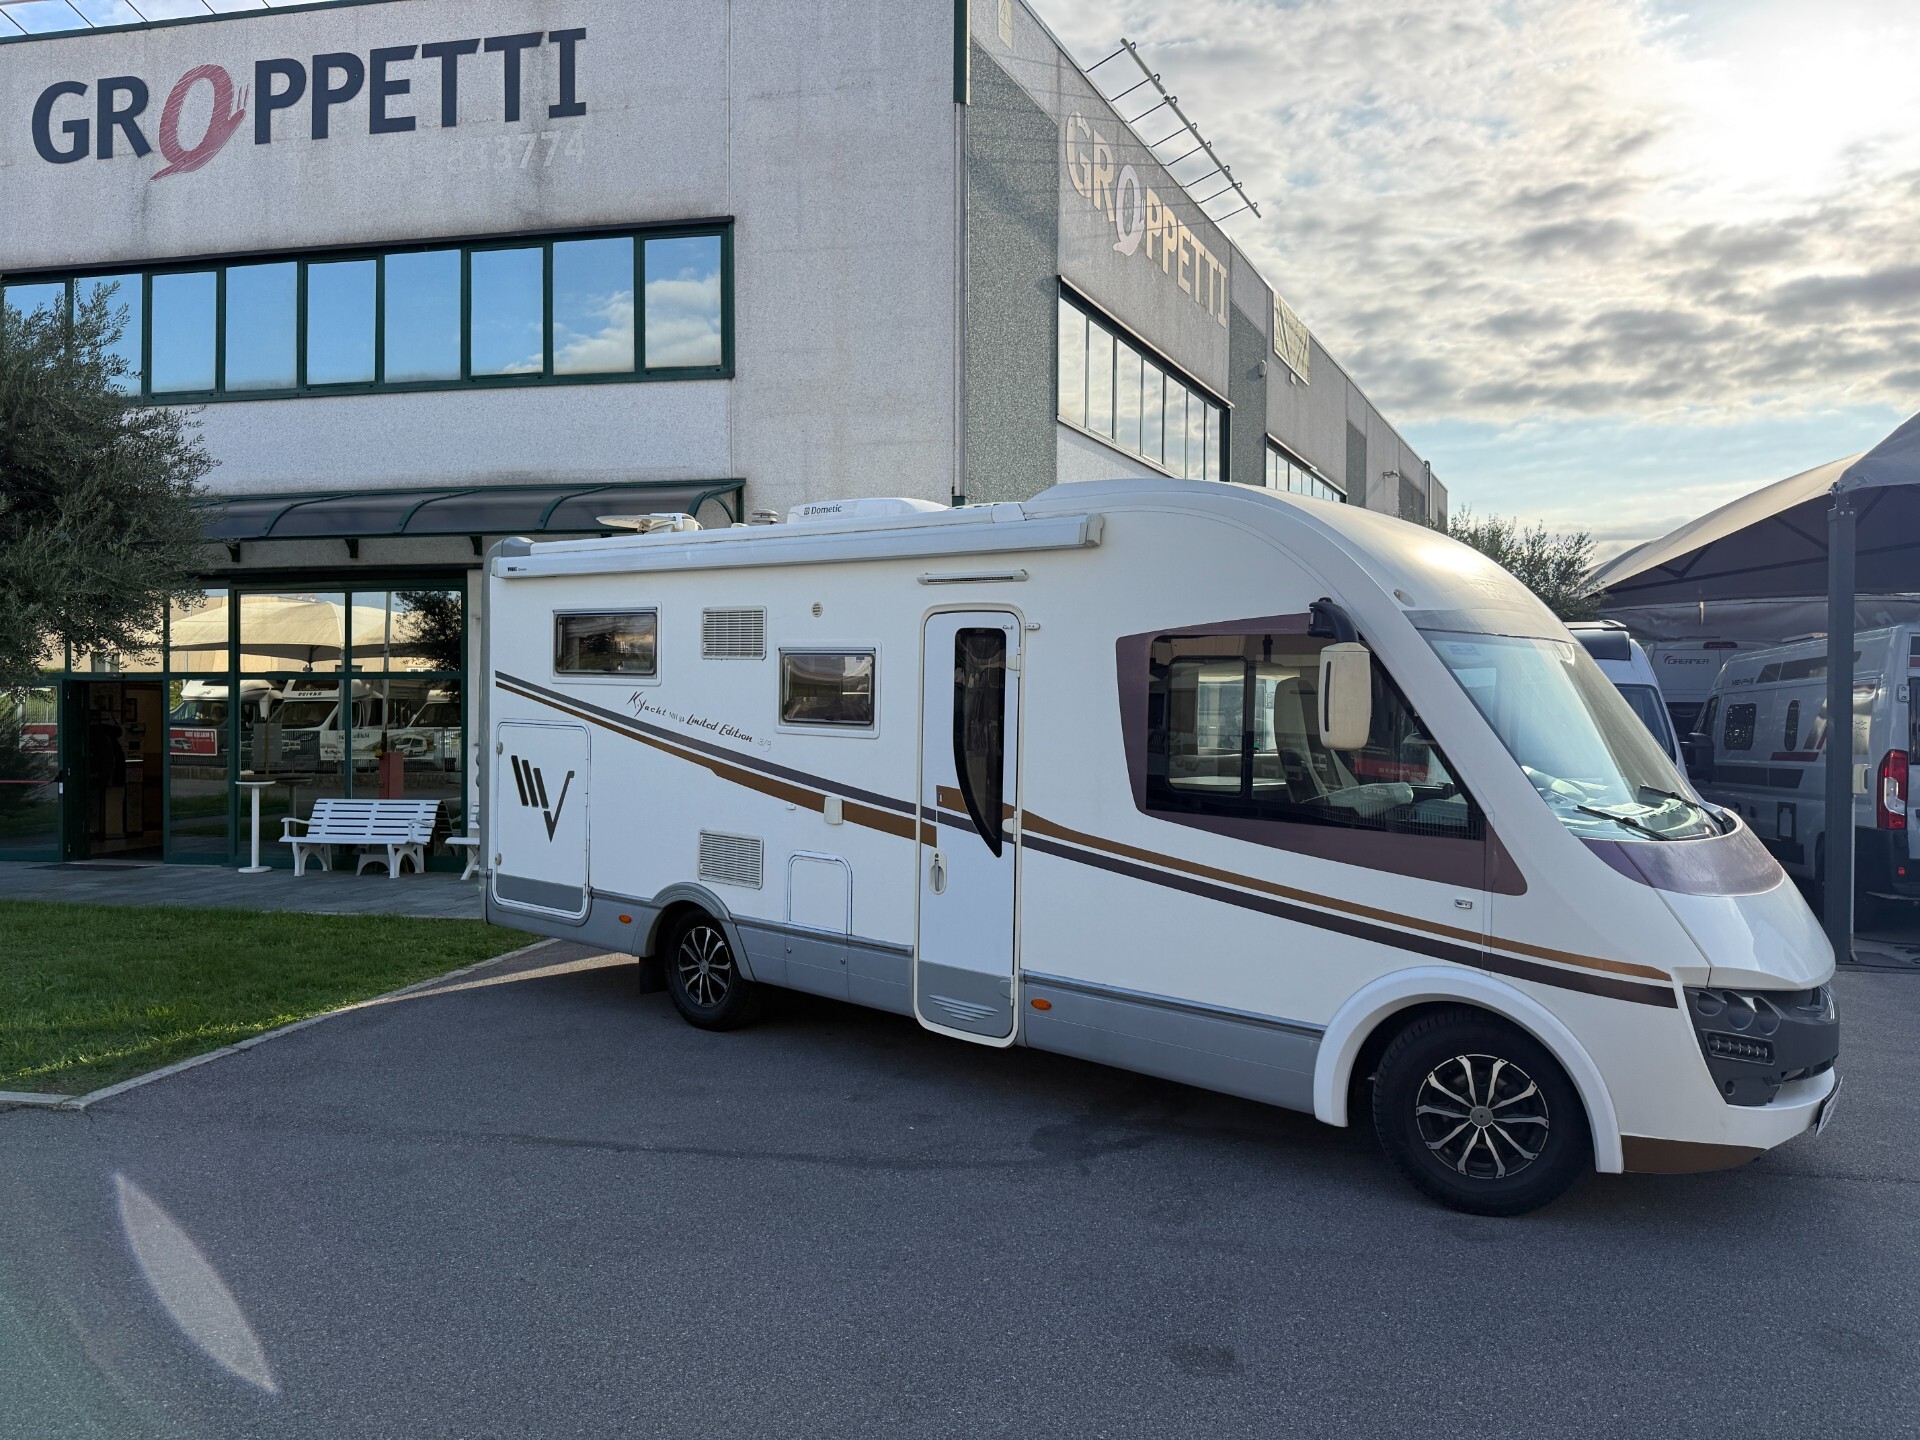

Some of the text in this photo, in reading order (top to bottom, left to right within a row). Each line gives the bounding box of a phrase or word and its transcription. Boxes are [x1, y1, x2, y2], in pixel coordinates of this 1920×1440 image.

[32, 28, 587, 181] GROPPETTI
[1066, 111, 1228, 329] GROPPETTI
[811, 504, 842, 515] Dometic
[686, 713, 720, 731] Limited
[718, 724, 753, 743] Edition
